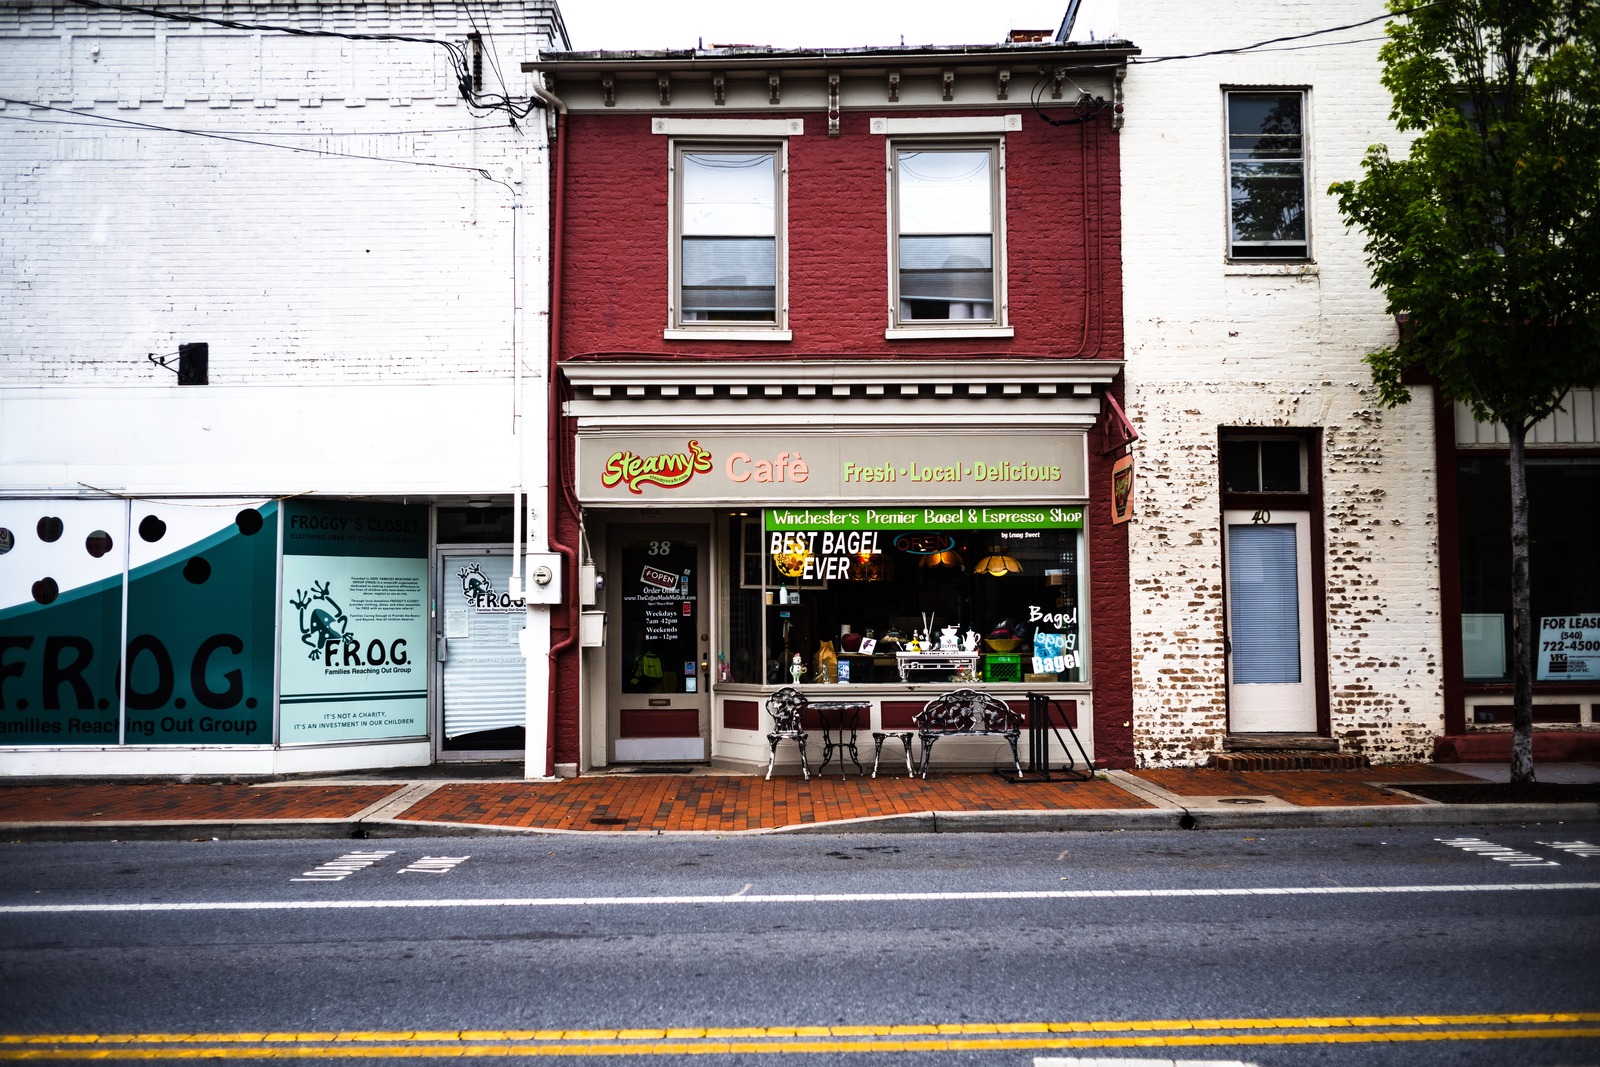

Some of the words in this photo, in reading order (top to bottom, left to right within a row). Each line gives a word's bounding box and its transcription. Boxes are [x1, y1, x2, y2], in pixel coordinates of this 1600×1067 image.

[602, 441, 712, 488] Steamy's
[843, 460, 896, 482] Fresh
[910, 461, 962, 482] Local
[974, 460, 1061, 482] Delicious
[290, 516, 362, 531] FROGGY'S
[368, 518, 420, 533] CLOSET
[773, 509, 860, 524] Winchester's
[866, 510, 918, 524] Premier
[968, 509, 978, 524] &
[982, 508, 1044, 524] Espresso
[1050, 508, 1082, 523] Shop
[1251, 510, 1270, 524] 40
[648, 541, 670, 556] 38
[770, 532, 819, 554] BEST
[822, 531, 882, 554] BAGEL
[896, 535, 948, 550] OPEN
[802, 557, 850, 580] EVER
[652, 572, 674, 584] OPEN
[1028, 605, 1077, 629] Bagel
[1543, 618, 1566, 630] FOR
[1561, 631, 1582, 640] (540)
[325, 638, 412, 666] F.R.O.G.
[1543, 641, 1600, 651] 722-4500
[1032, 650, 1080, 674] Bagel
[0, 718, 61, 733] amilies
[160, 717, 194, 732] Out
[199, 716, 257, 735] Group
